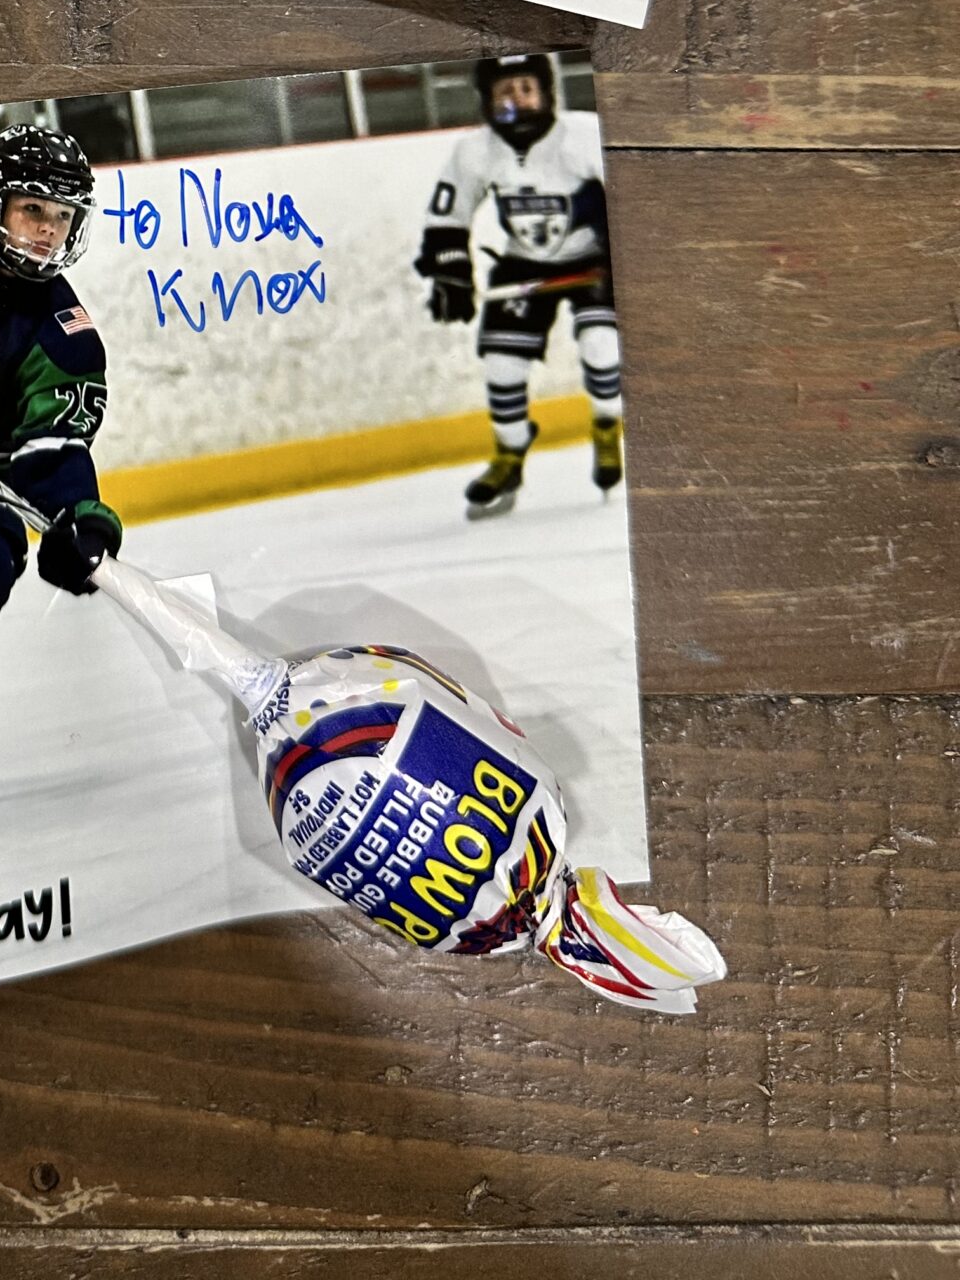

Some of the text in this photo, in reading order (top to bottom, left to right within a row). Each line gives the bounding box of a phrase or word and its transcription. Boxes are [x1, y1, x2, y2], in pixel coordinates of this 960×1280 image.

[103, 167, 324, 250] to Nova
[147, 260, 326, 333] Knox
[349, 770, 381, 812] NOT
[354, 773, 425, 866] FILLED
[376, 779, 456, 888] BUBBLE
[409, 759, 526, 917] BLOW
